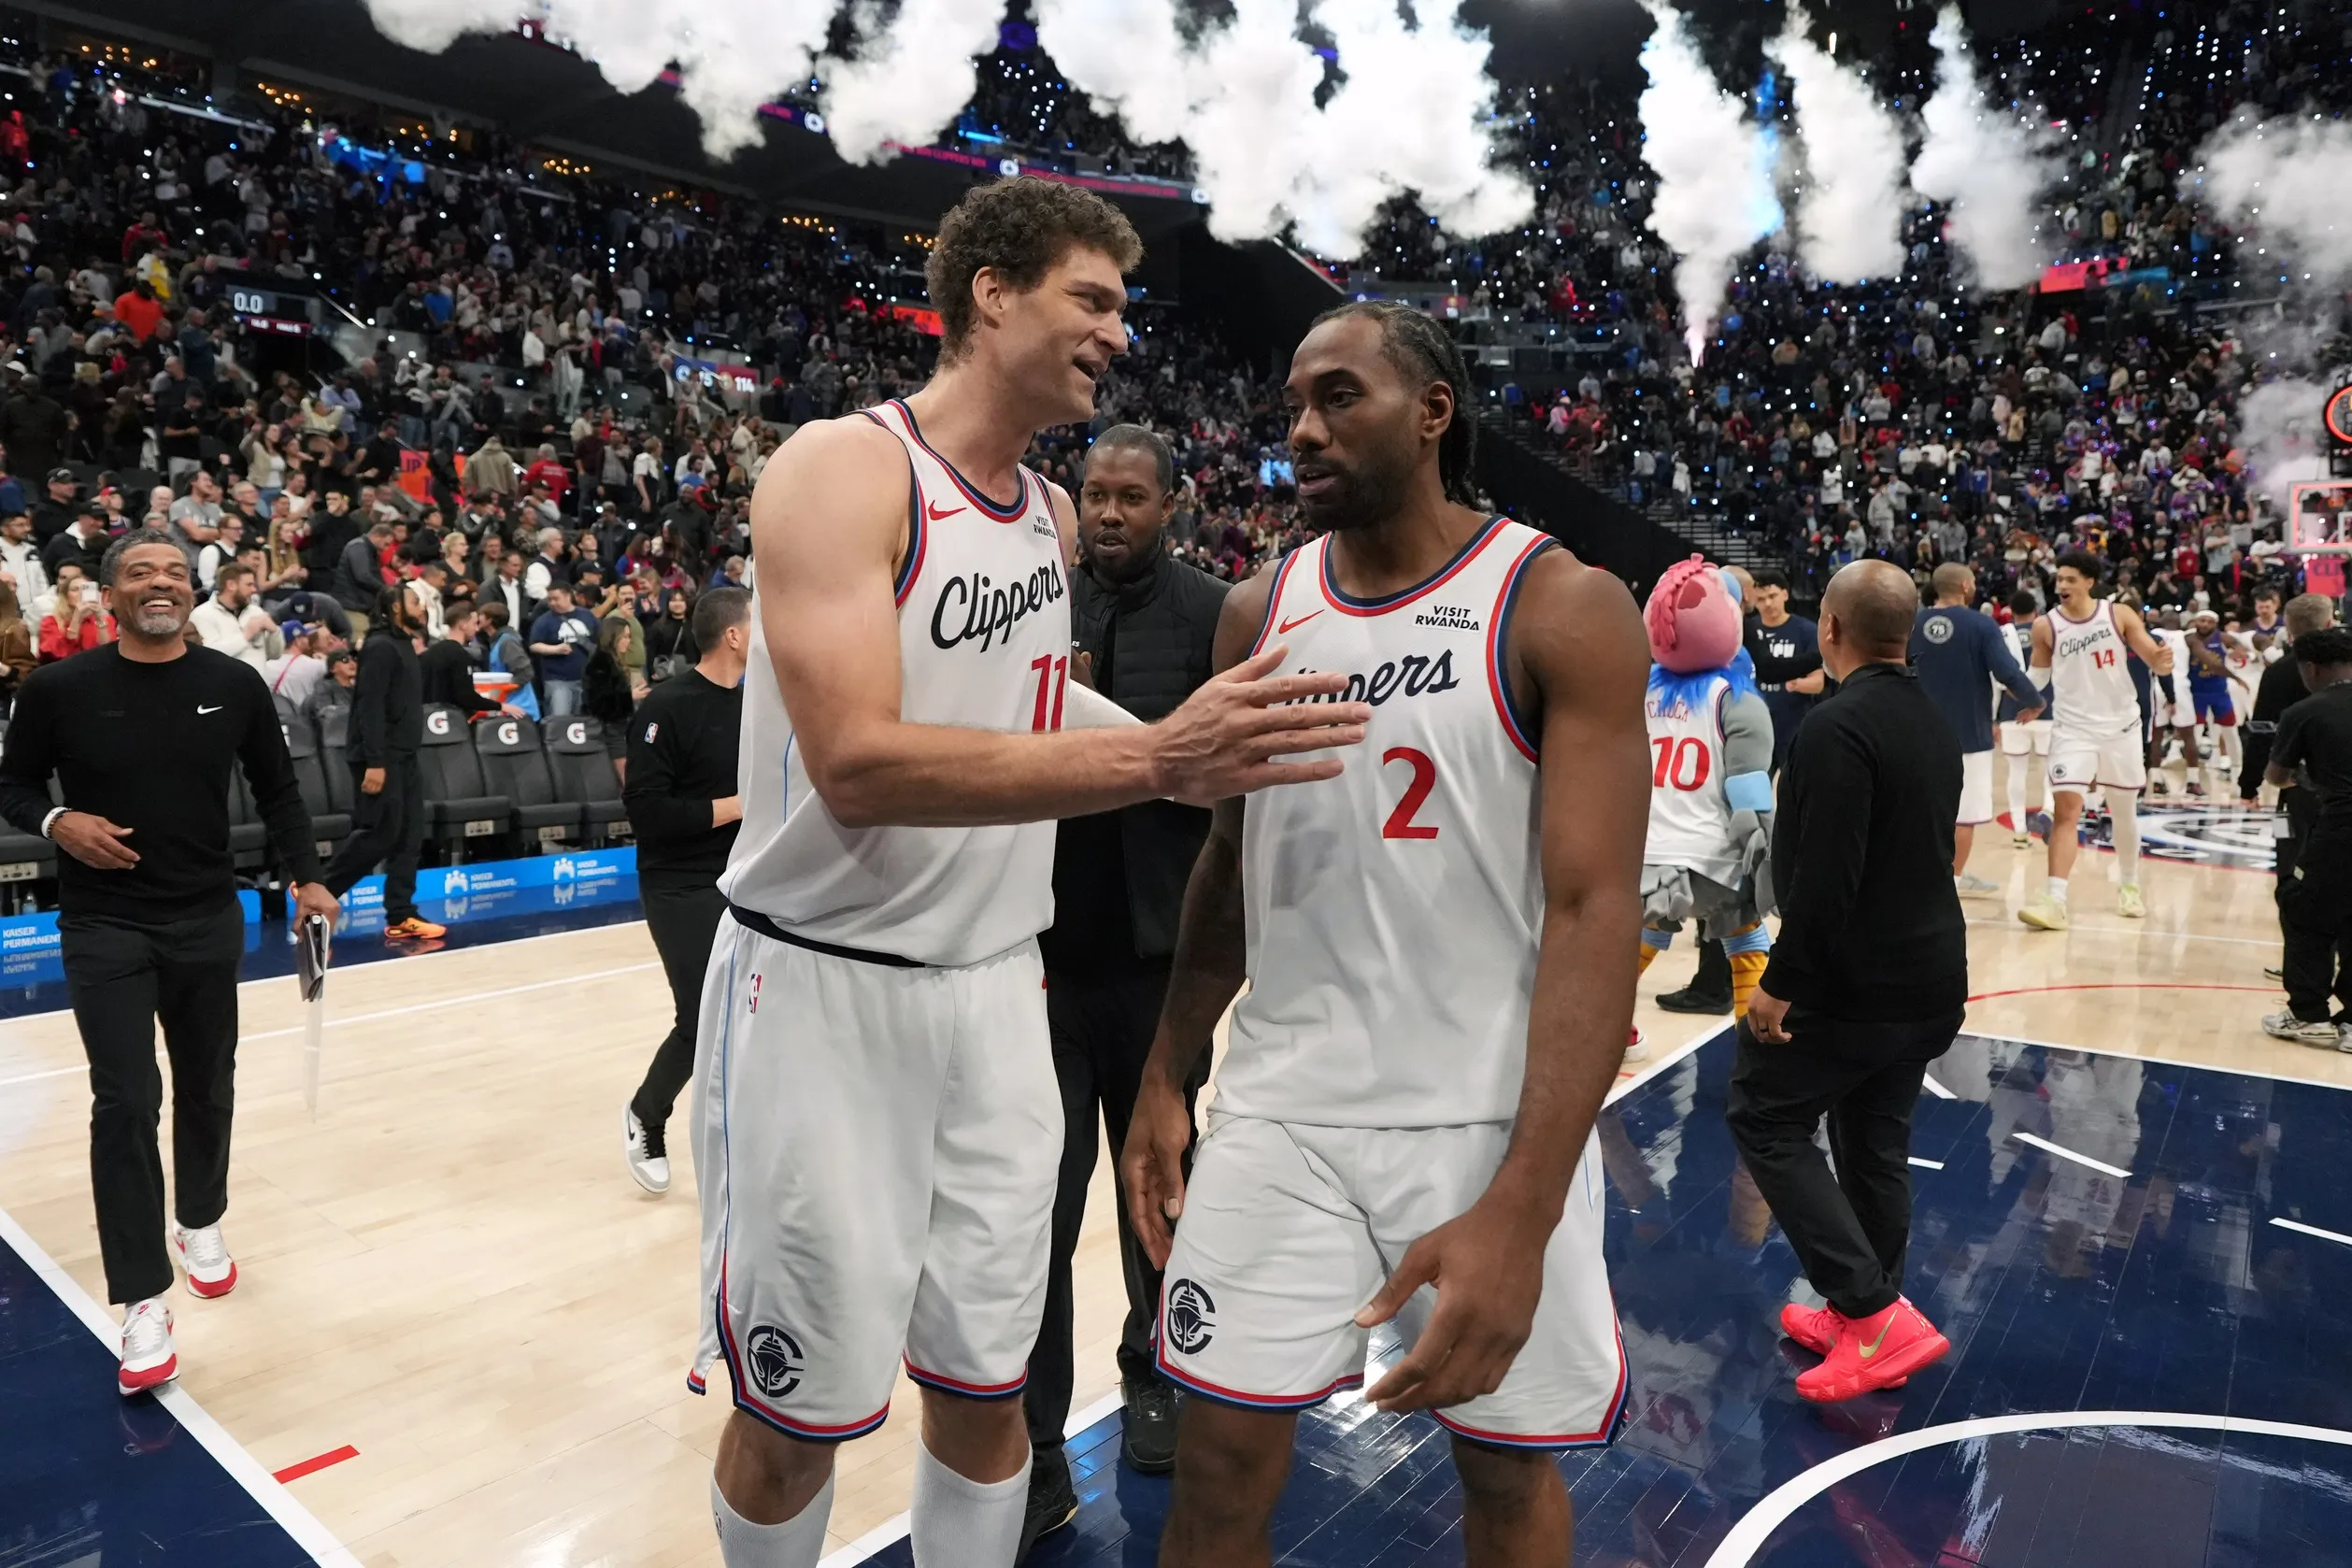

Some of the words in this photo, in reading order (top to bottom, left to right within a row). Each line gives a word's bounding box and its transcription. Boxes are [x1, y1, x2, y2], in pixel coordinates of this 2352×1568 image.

[234, 292, 264, 314] 0.0
[930, 559, 1064, 653] Clippers
[1433, 605, 1471, 619] VISIT
[1415, 615, 1480, 632] RWANDA
[2060, 627, 2113, 658] Clippers
[2090, 649, 2116, 670] 14
[1031, 653, 1067, 734] 11
[426, 710, 449, 735] G
[497, 721, 520, 746] G
[566, 722, 587, 745] G
[1652, 735, 1710, 792] 10
[1382, 746, 1440, 840] 2
[2, 926, 36, 938] KAISER
[3, 934, 61, 949] PERMANENT
